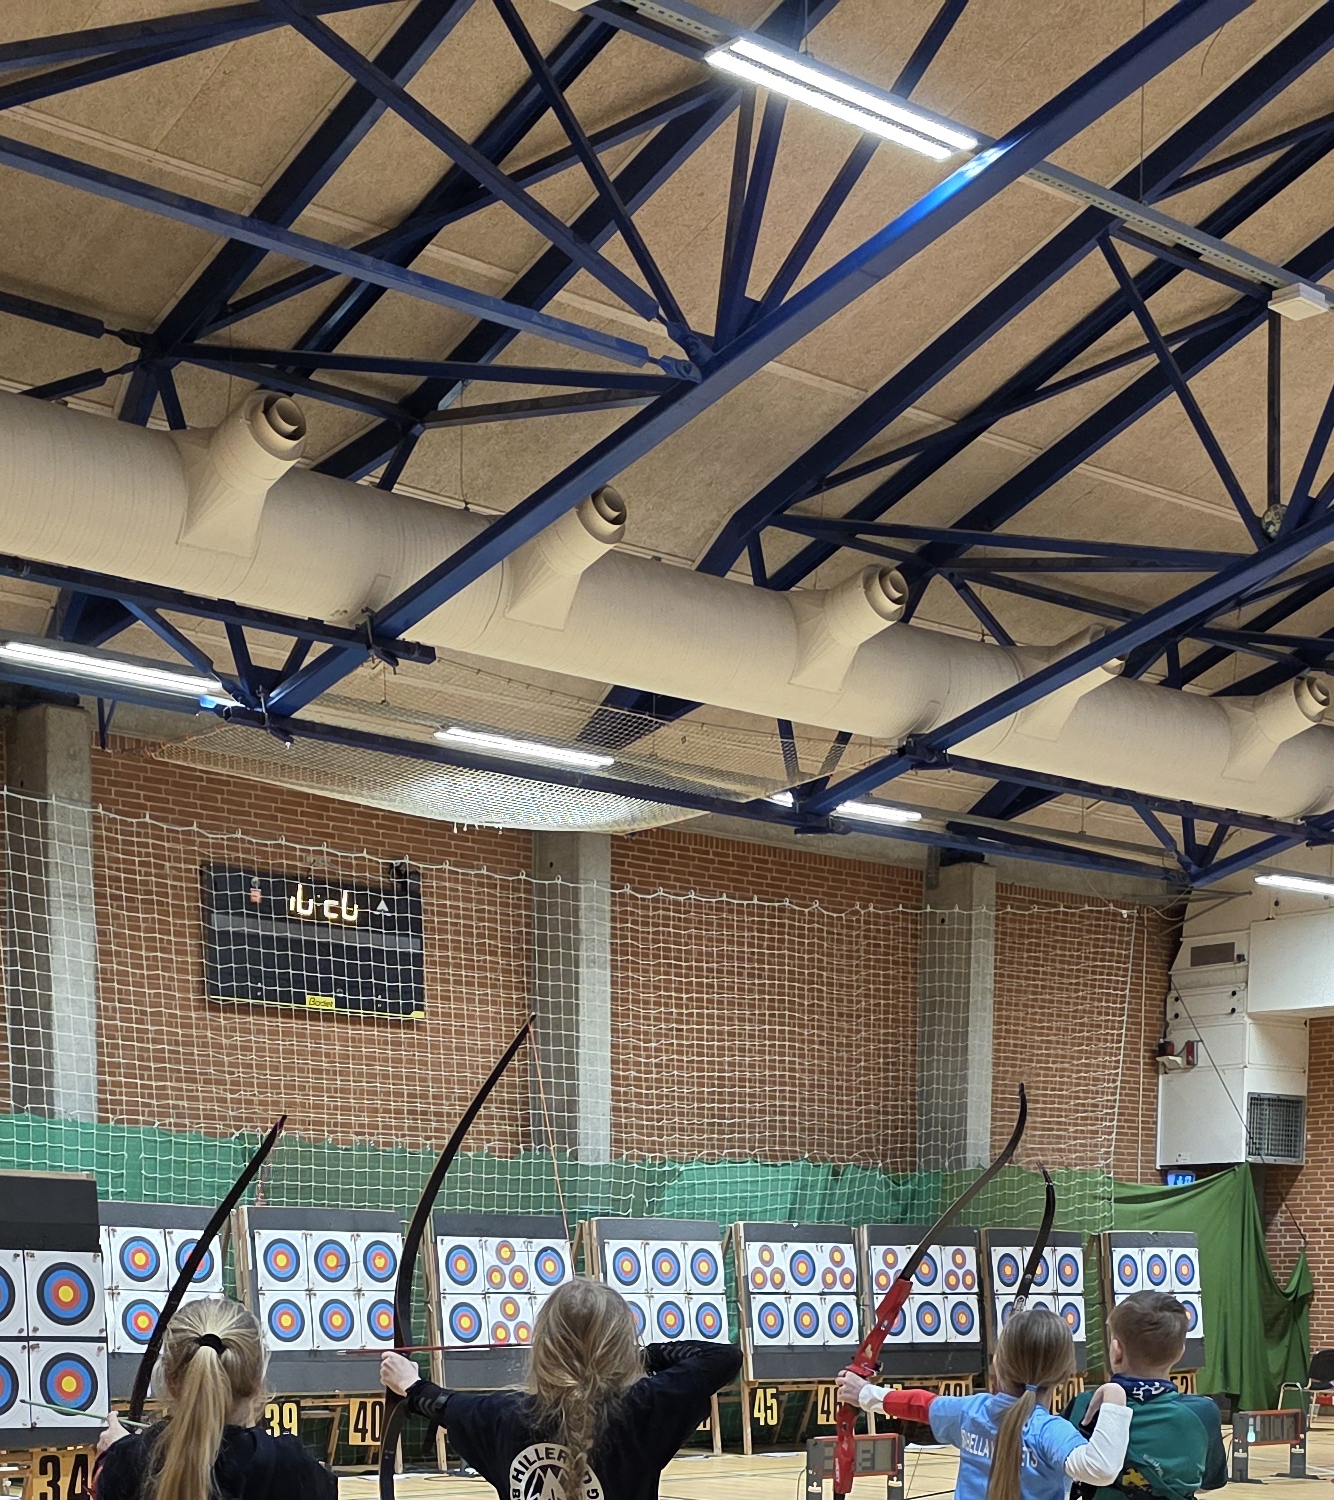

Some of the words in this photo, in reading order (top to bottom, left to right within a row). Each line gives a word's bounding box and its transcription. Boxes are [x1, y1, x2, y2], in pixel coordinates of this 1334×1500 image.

[266, 1402, 298, 1436] 39
[353, 1400, 383, 1443] 40
[753, 1388, 779, 1426] 45
